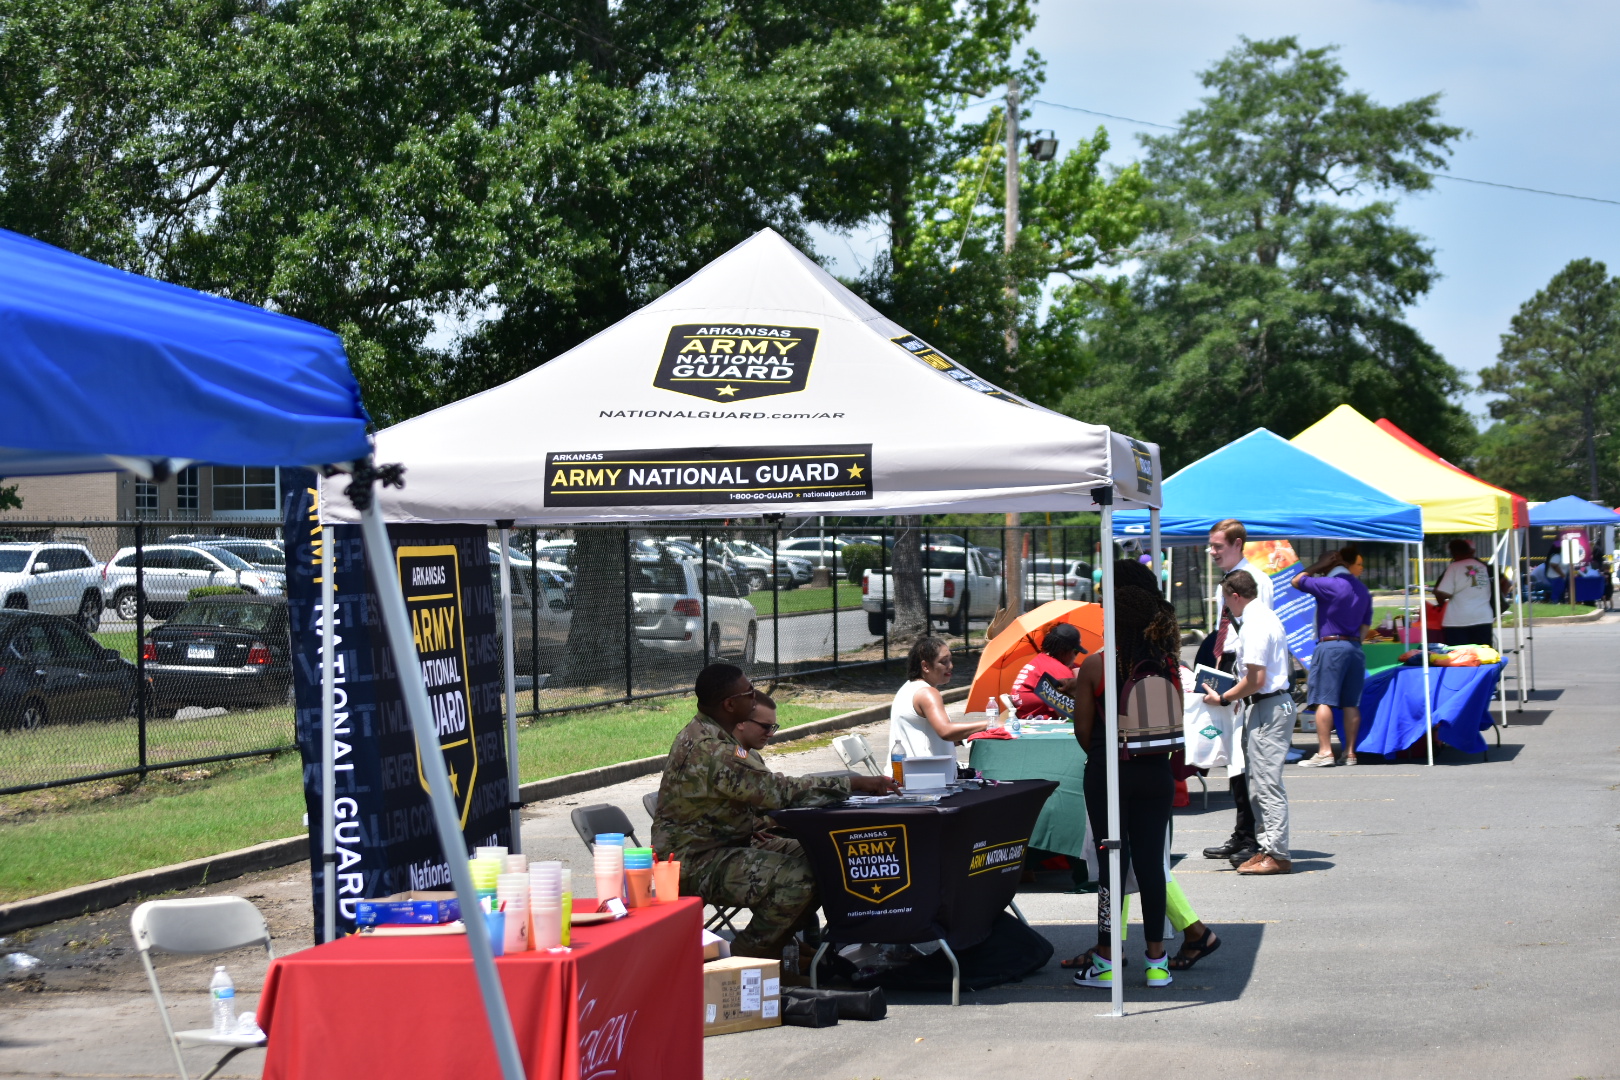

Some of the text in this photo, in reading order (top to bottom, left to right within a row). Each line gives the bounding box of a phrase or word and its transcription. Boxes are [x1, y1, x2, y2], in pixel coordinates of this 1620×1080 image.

[696, 326, 791, 337] ARKANSAS
[680, 338, 799, 355] ARMY
[676, 354, 795, 366] NATIONAL
[672, 365, 794, 380] GUARD
[599, 410, 845, 419] NATIONALGUARD.com/AR
[552, 453, 604, 462] ARKANSAS
[551, 462, 839, 487] ARMY NATIONAL GUARD
[729, 489, 866, 500] 1-800-GO-GUARD nationalguard.com
[412, 565, 446, 586] ARKANSAS
[412, 605, 455, 653] ARMY
[419, 656, 461, 688] ATIONAL
[1039, 691, 1074, 714] ARMY
[428, 690, 466, 738] UARD
[849, 831, 888, 840] ARKANSAS
[847, 840, 896, 857] ARMY
[334, 797, 365, 919] GUARD
[848, 855, 899, 866] NATIONAL
[969, 853, 988, 871] ARMY
[850, 863, 900, 879] GUARD
